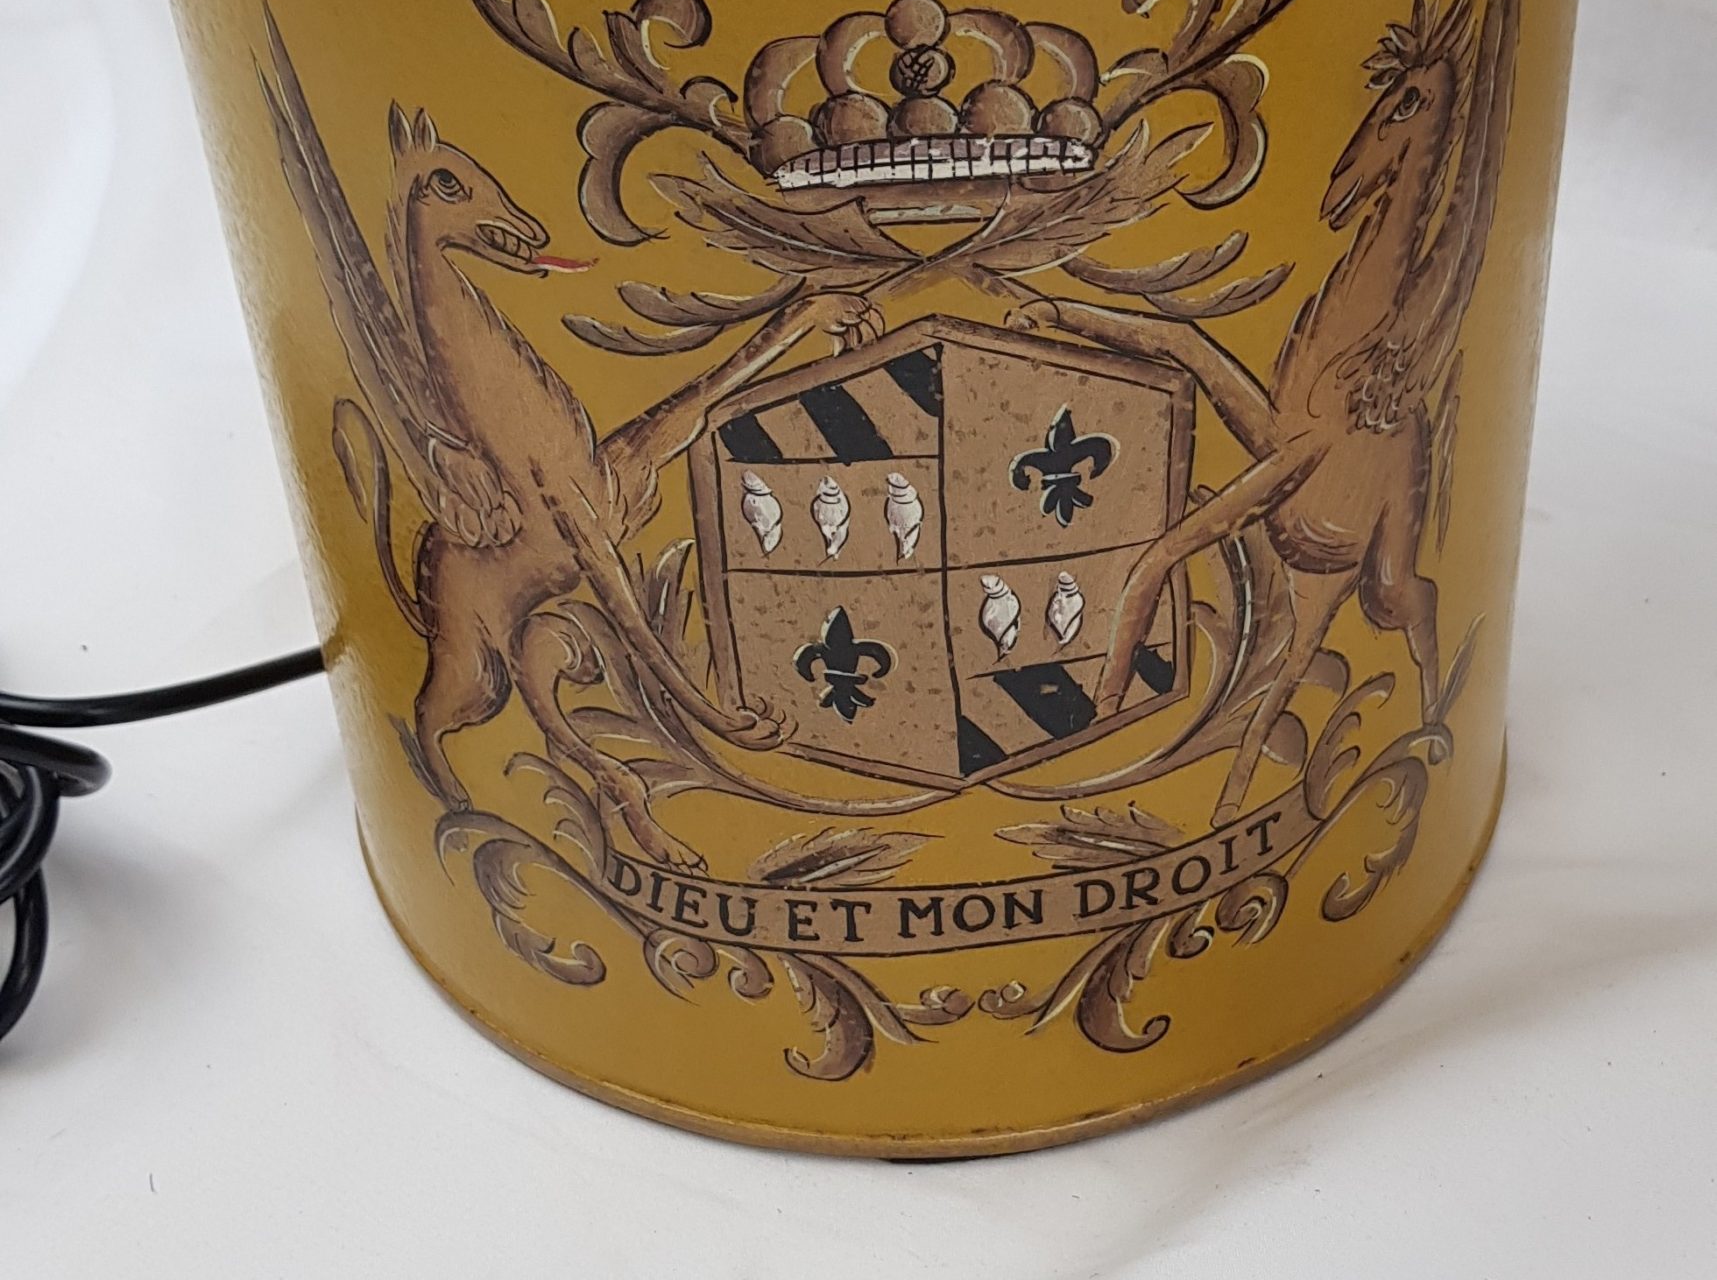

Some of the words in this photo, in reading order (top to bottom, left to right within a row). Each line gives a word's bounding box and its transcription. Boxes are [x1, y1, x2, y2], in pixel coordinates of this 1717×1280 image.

[608, 856, 758, 937] DIEU
[786, 897, 872, 942] ET
[898, 889, 1044, 939] MON
[1072, 812, 1281, 918] DROIT
